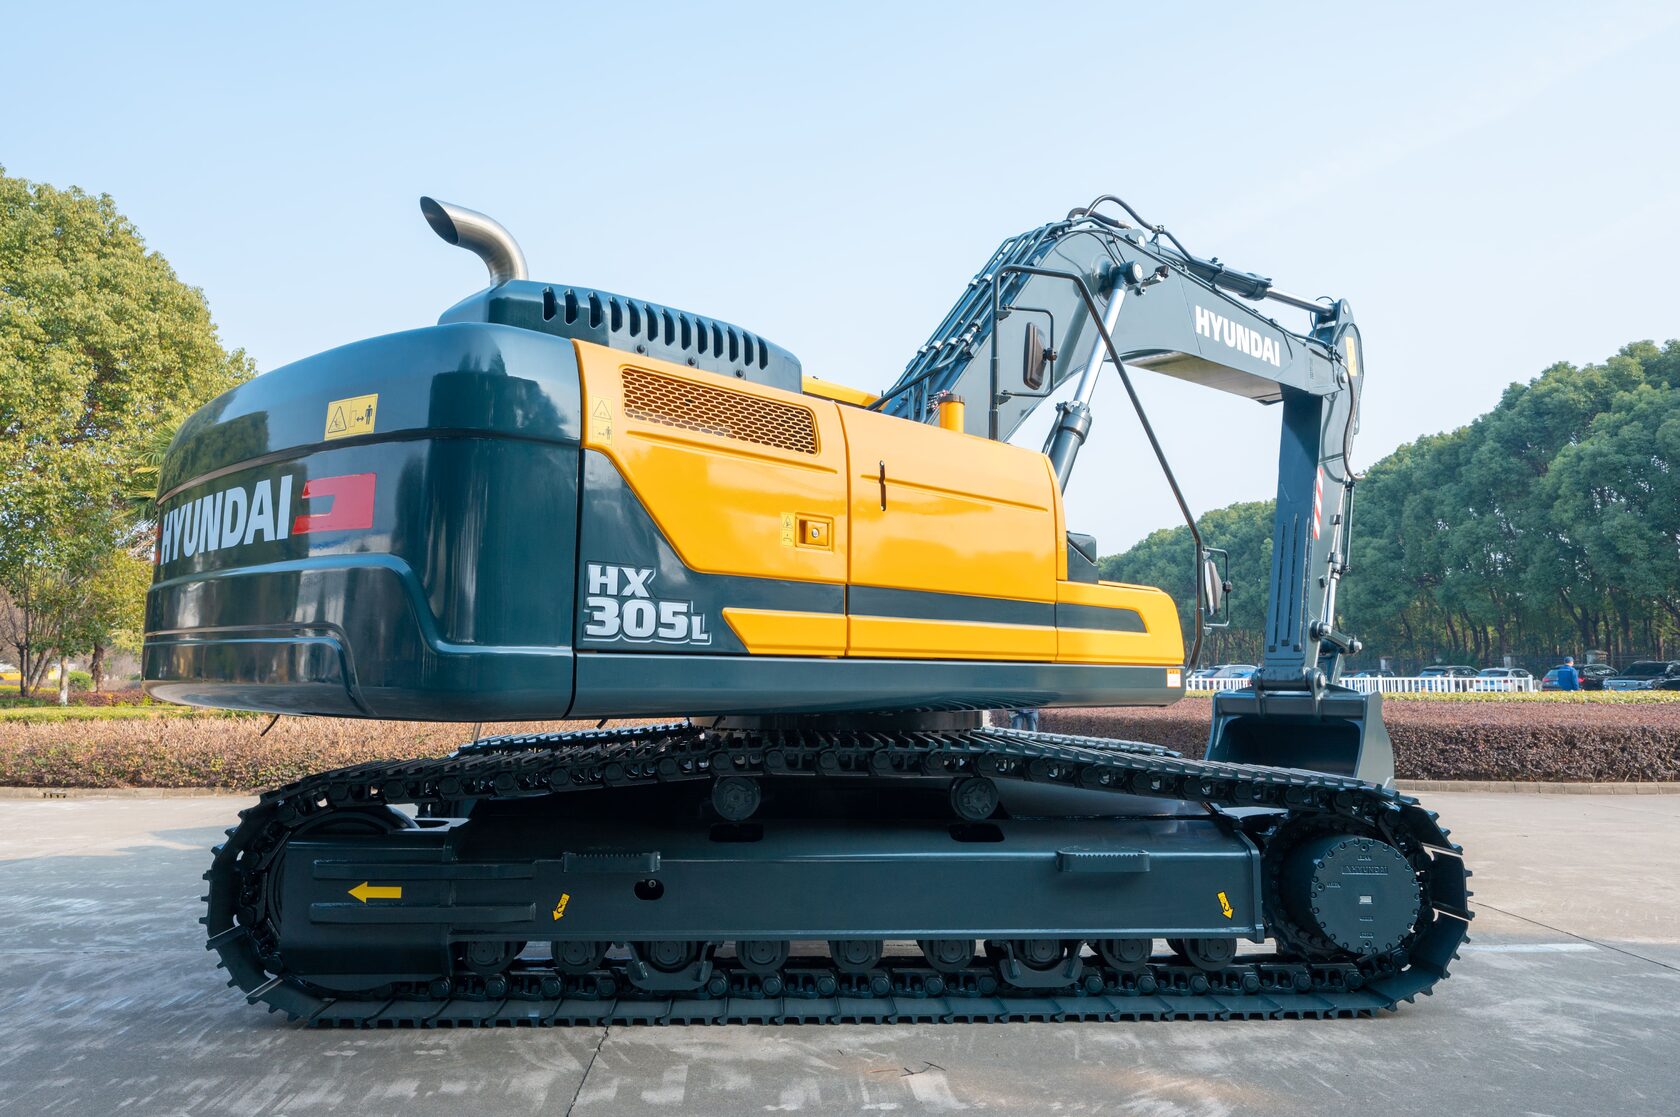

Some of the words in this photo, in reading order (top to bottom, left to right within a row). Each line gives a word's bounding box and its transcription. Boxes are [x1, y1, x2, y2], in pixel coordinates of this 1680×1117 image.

[1195, 304, 1280, 367] HYUNDAI
[160, 474, 293, 566] HYUNDAI
[588, 563, 654, 598] HX
